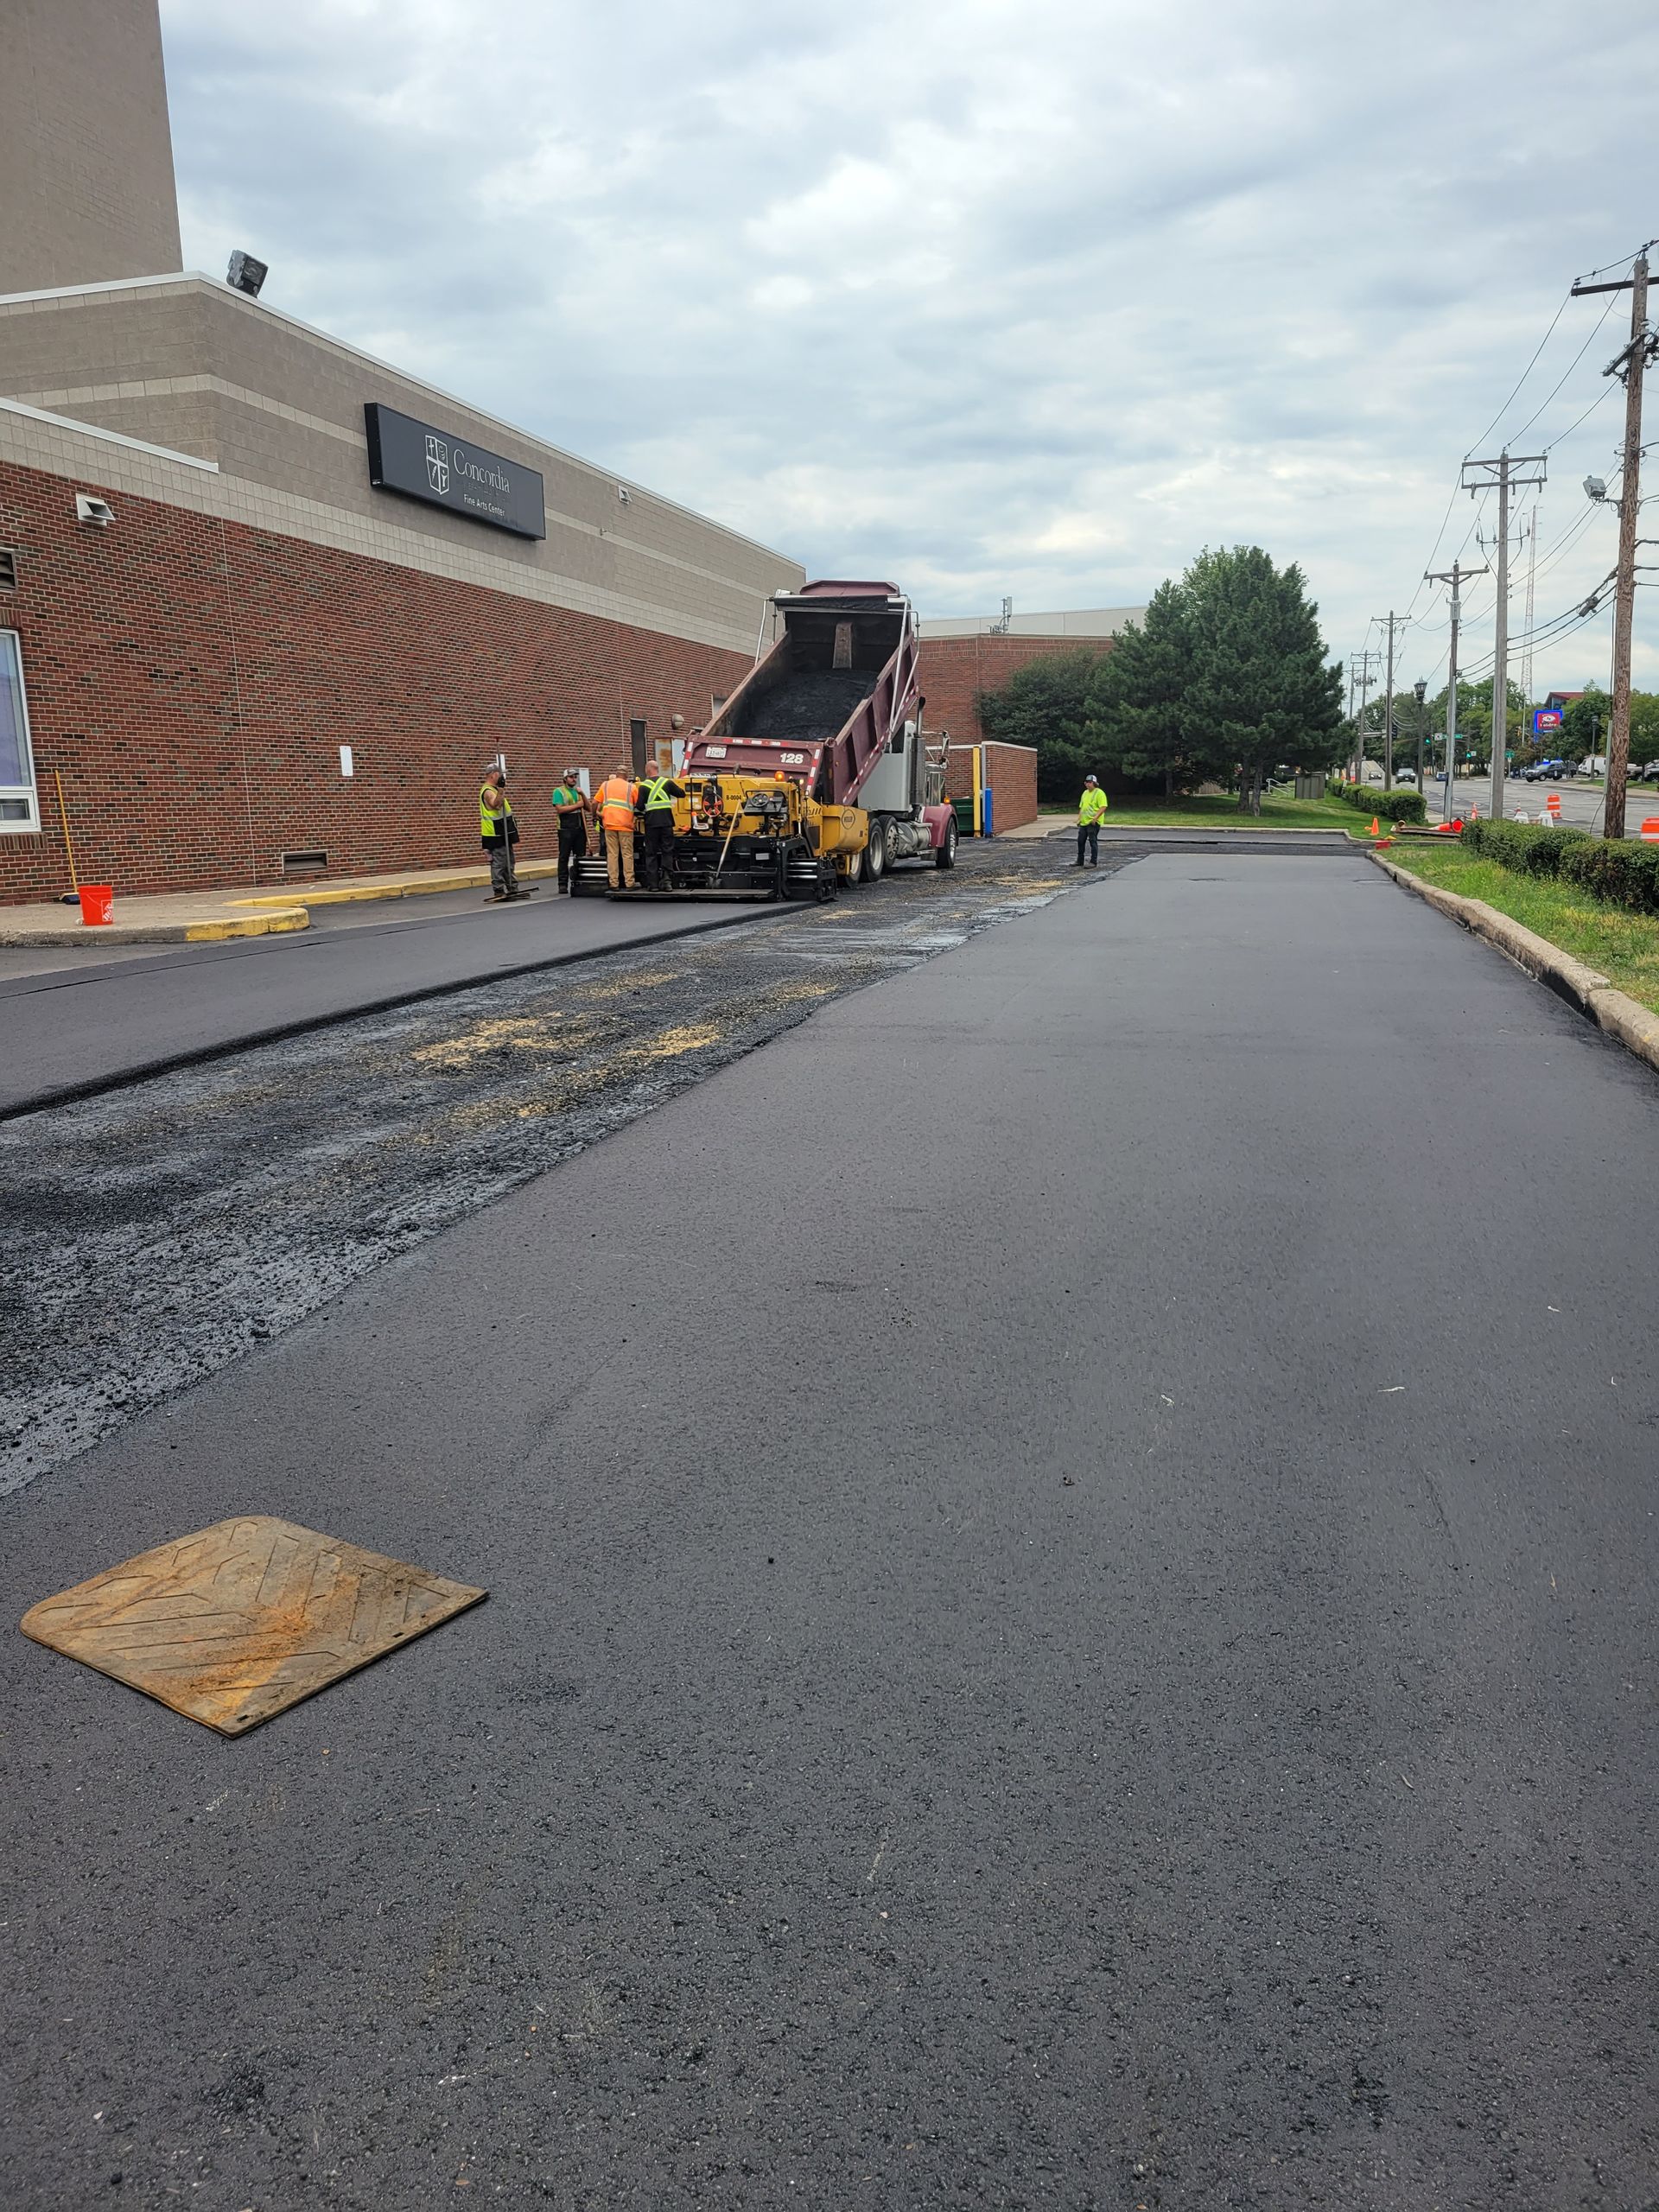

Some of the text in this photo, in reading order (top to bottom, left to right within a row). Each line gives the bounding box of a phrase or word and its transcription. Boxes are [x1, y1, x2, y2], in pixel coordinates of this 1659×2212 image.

[454, 449, 510, 493] Concordia
[464, 493, 505, 516] Fine Arts Center
[780, 753, 804, 764] 128
